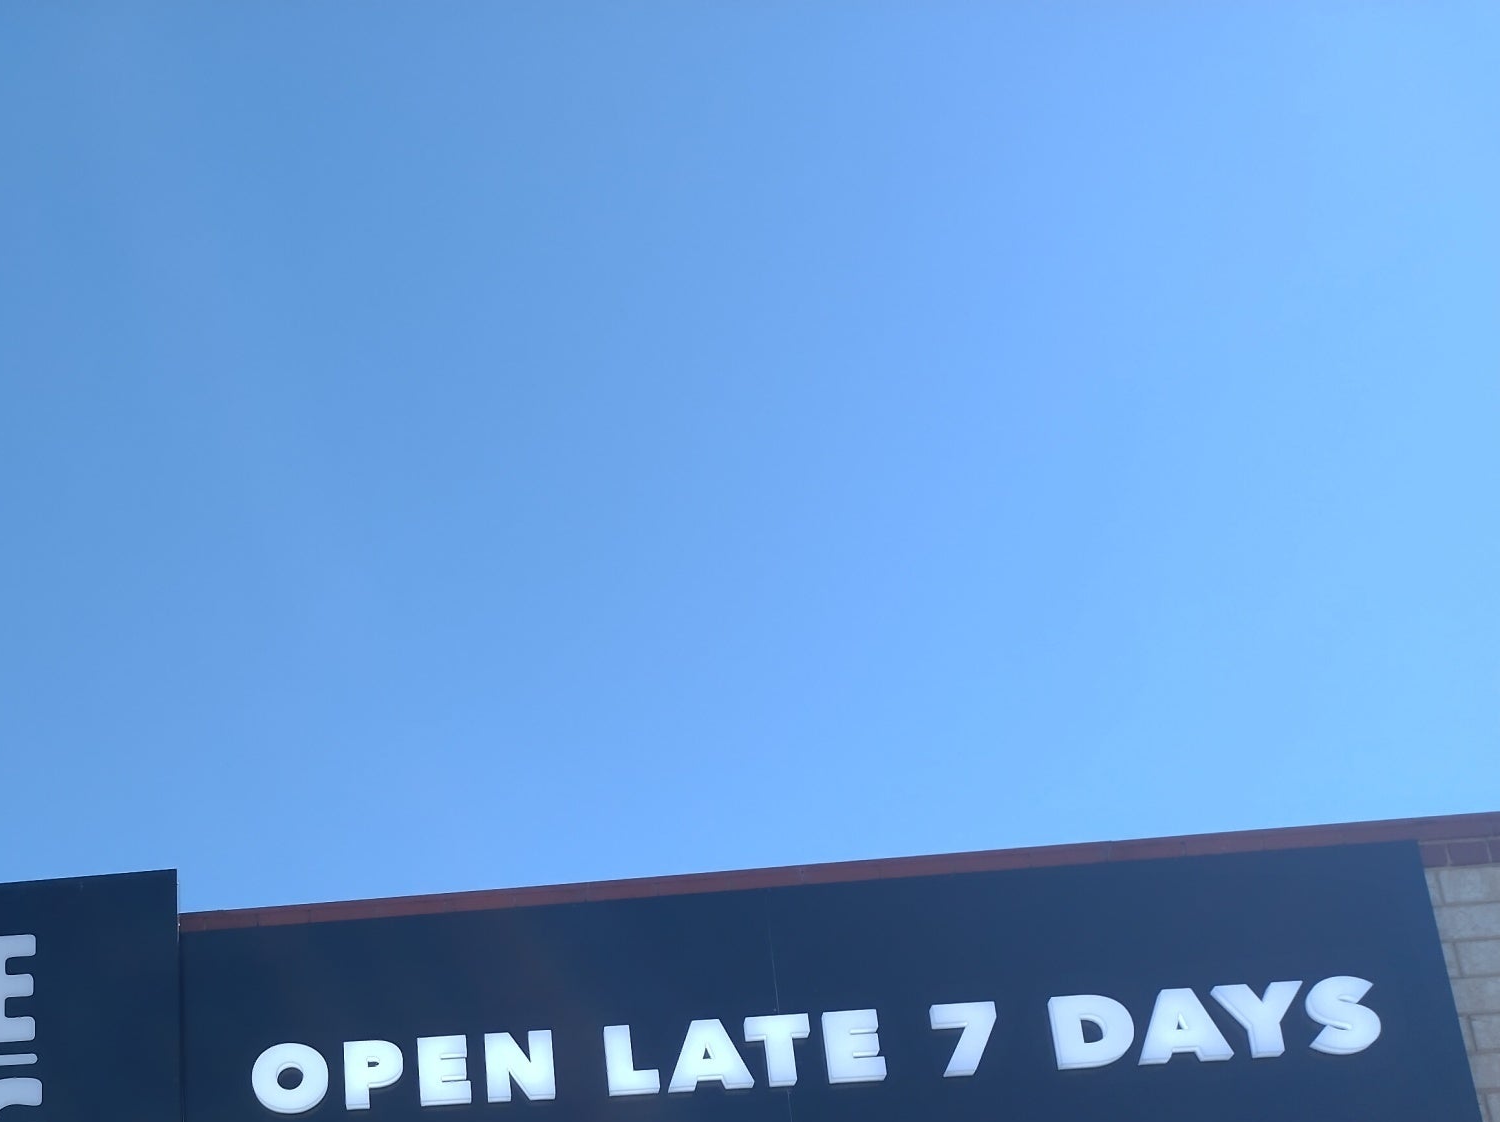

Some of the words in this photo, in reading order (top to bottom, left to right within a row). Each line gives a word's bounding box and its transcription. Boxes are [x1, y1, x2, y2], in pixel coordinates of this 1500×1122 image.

[252, 1029, 556, 1112] OPEN
[604, 1008, 888, 1096] LATE
[929, 1000, 997, 1077] 7
[1046, 975, 1383, 1071] DAYS
